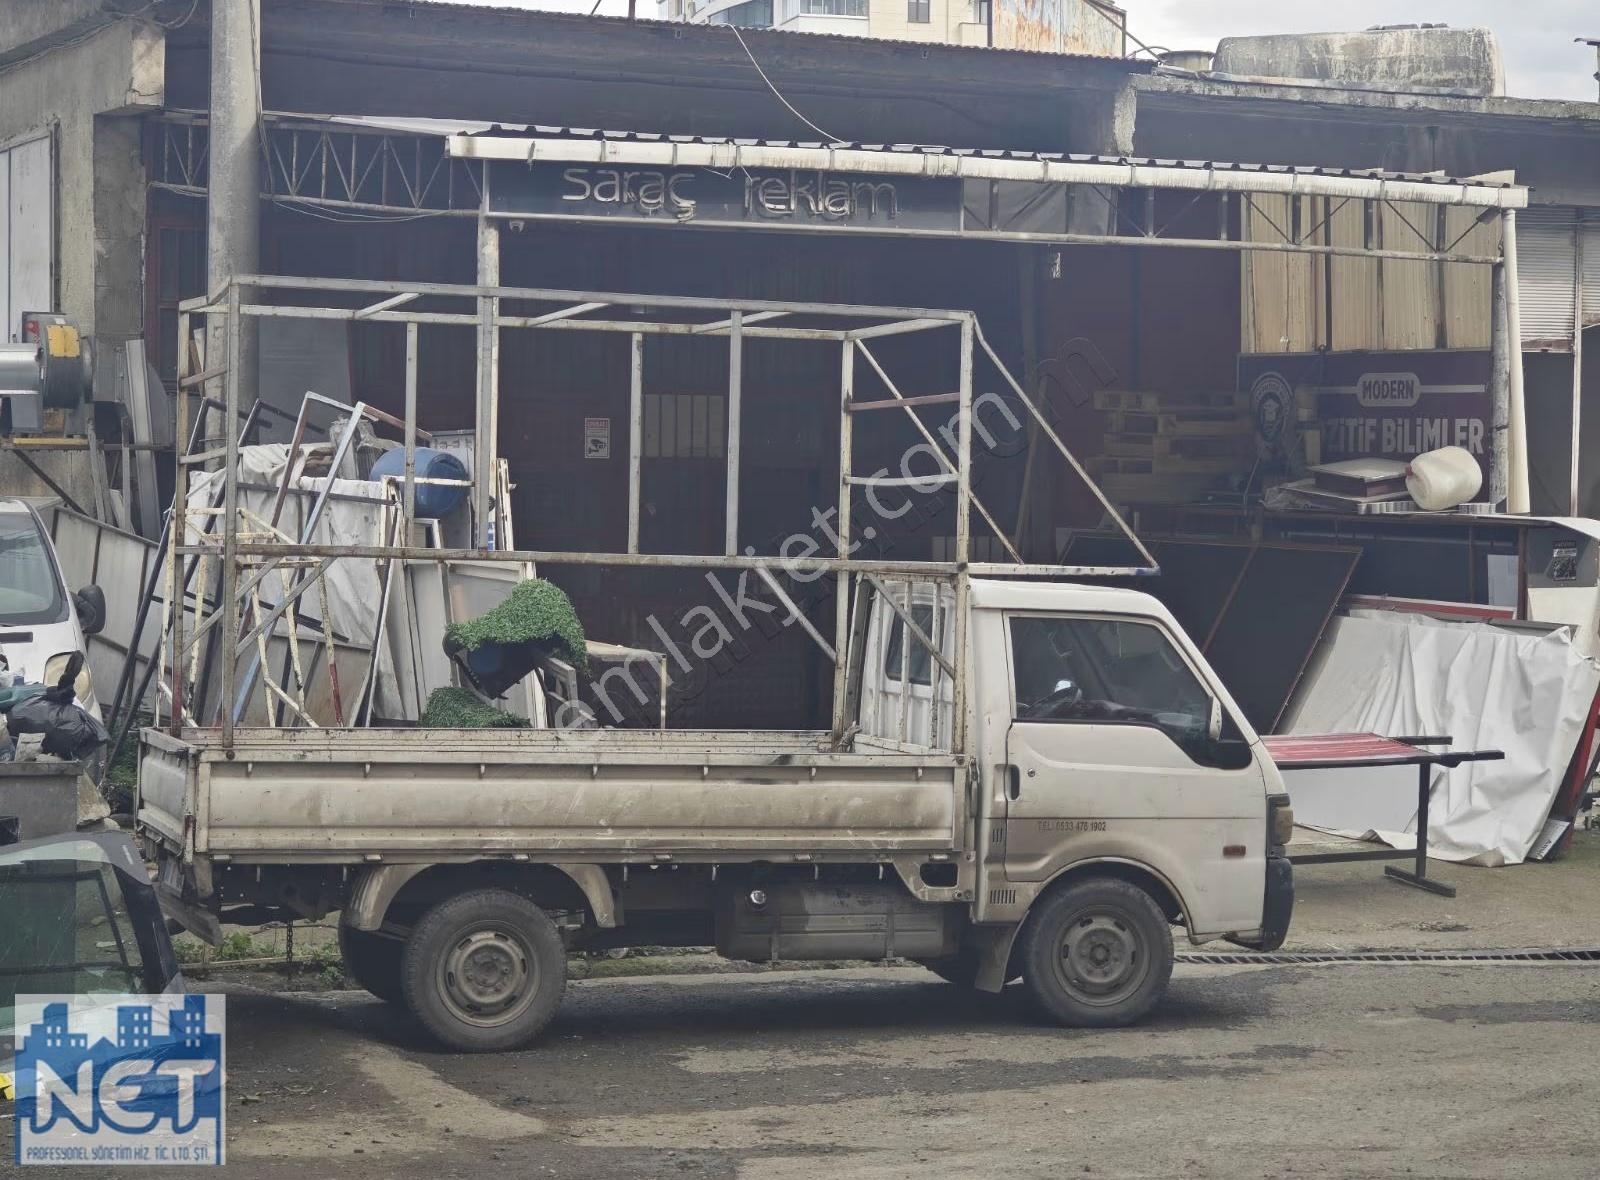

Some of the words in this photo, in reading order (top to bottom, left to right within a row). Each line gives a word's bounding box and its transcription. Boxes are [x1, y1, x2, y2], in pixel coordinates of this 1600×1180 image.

[743, 169, 899, 217] reklam
[1362, 379, 1415, 400] MODERN
[1325, 418, 1376, 453] ZİTİF
[1090, 821, 1106, 831] 1902
